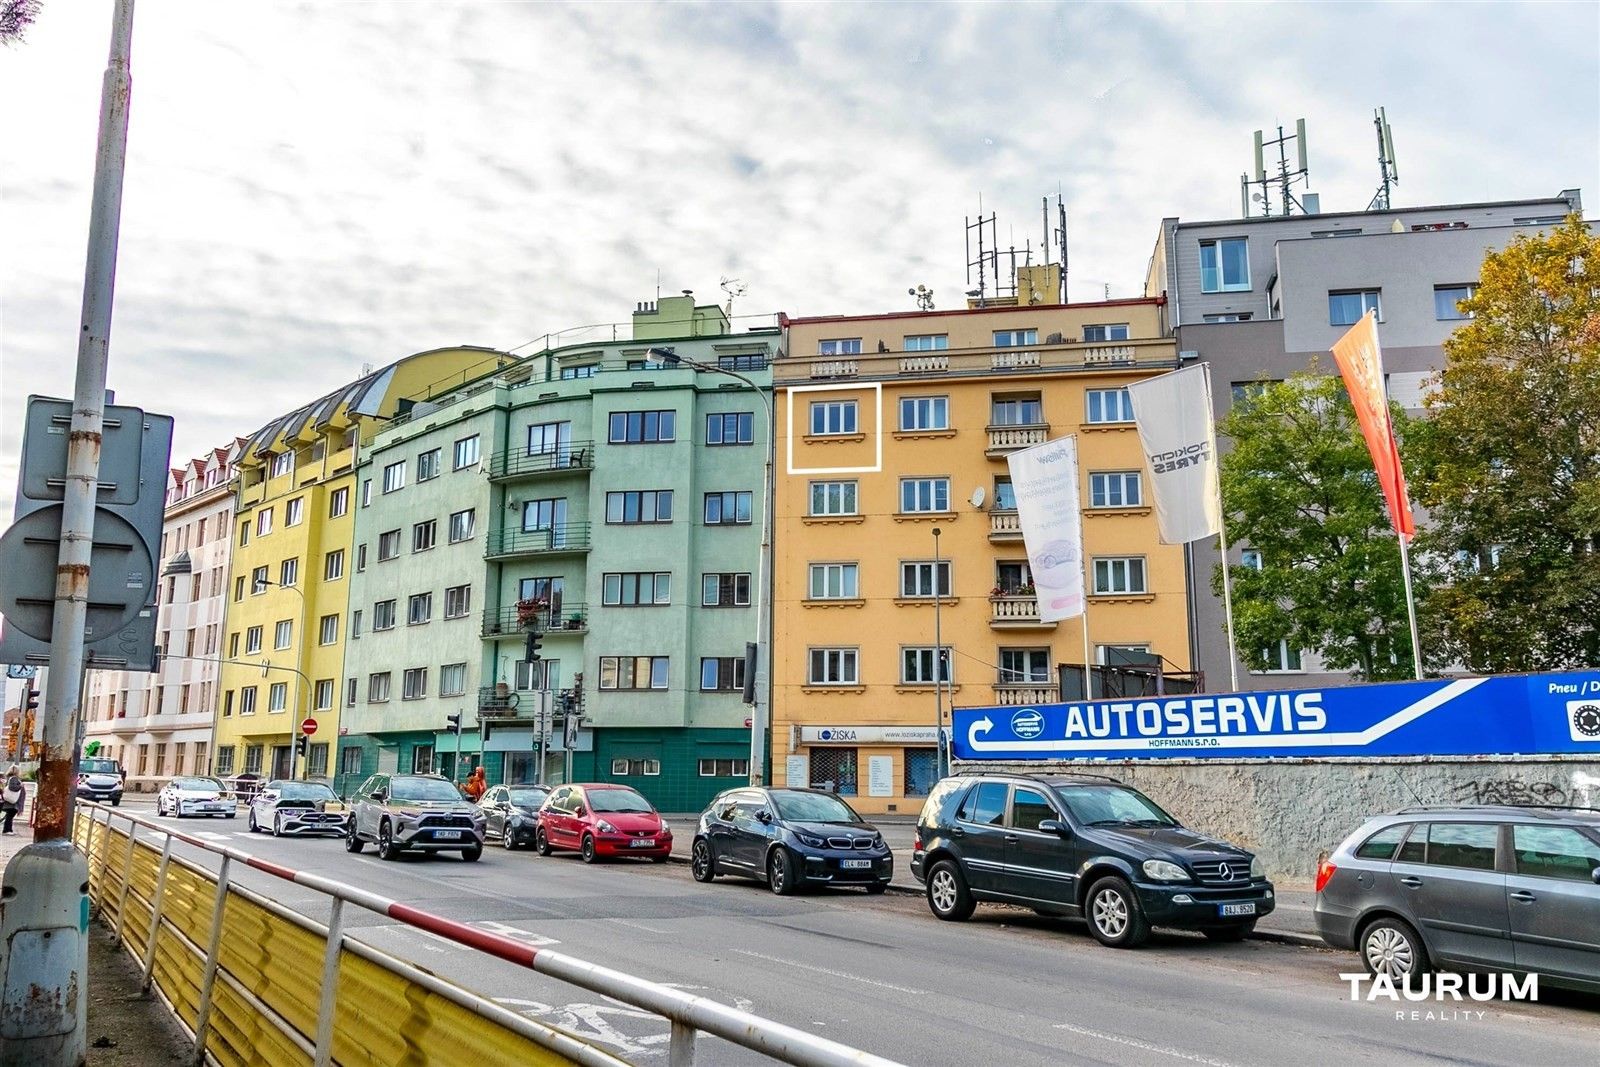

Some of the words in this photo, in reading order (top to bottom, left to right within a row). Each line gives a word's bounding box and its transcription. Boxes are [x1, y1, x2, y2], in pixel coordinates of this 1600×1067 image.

[1548, 682, 1578, 694] Pneu
[1064, 692, 1327, 738] AUTOSERVIS
[1148, 739, 1194, 747] HOFFMANN
